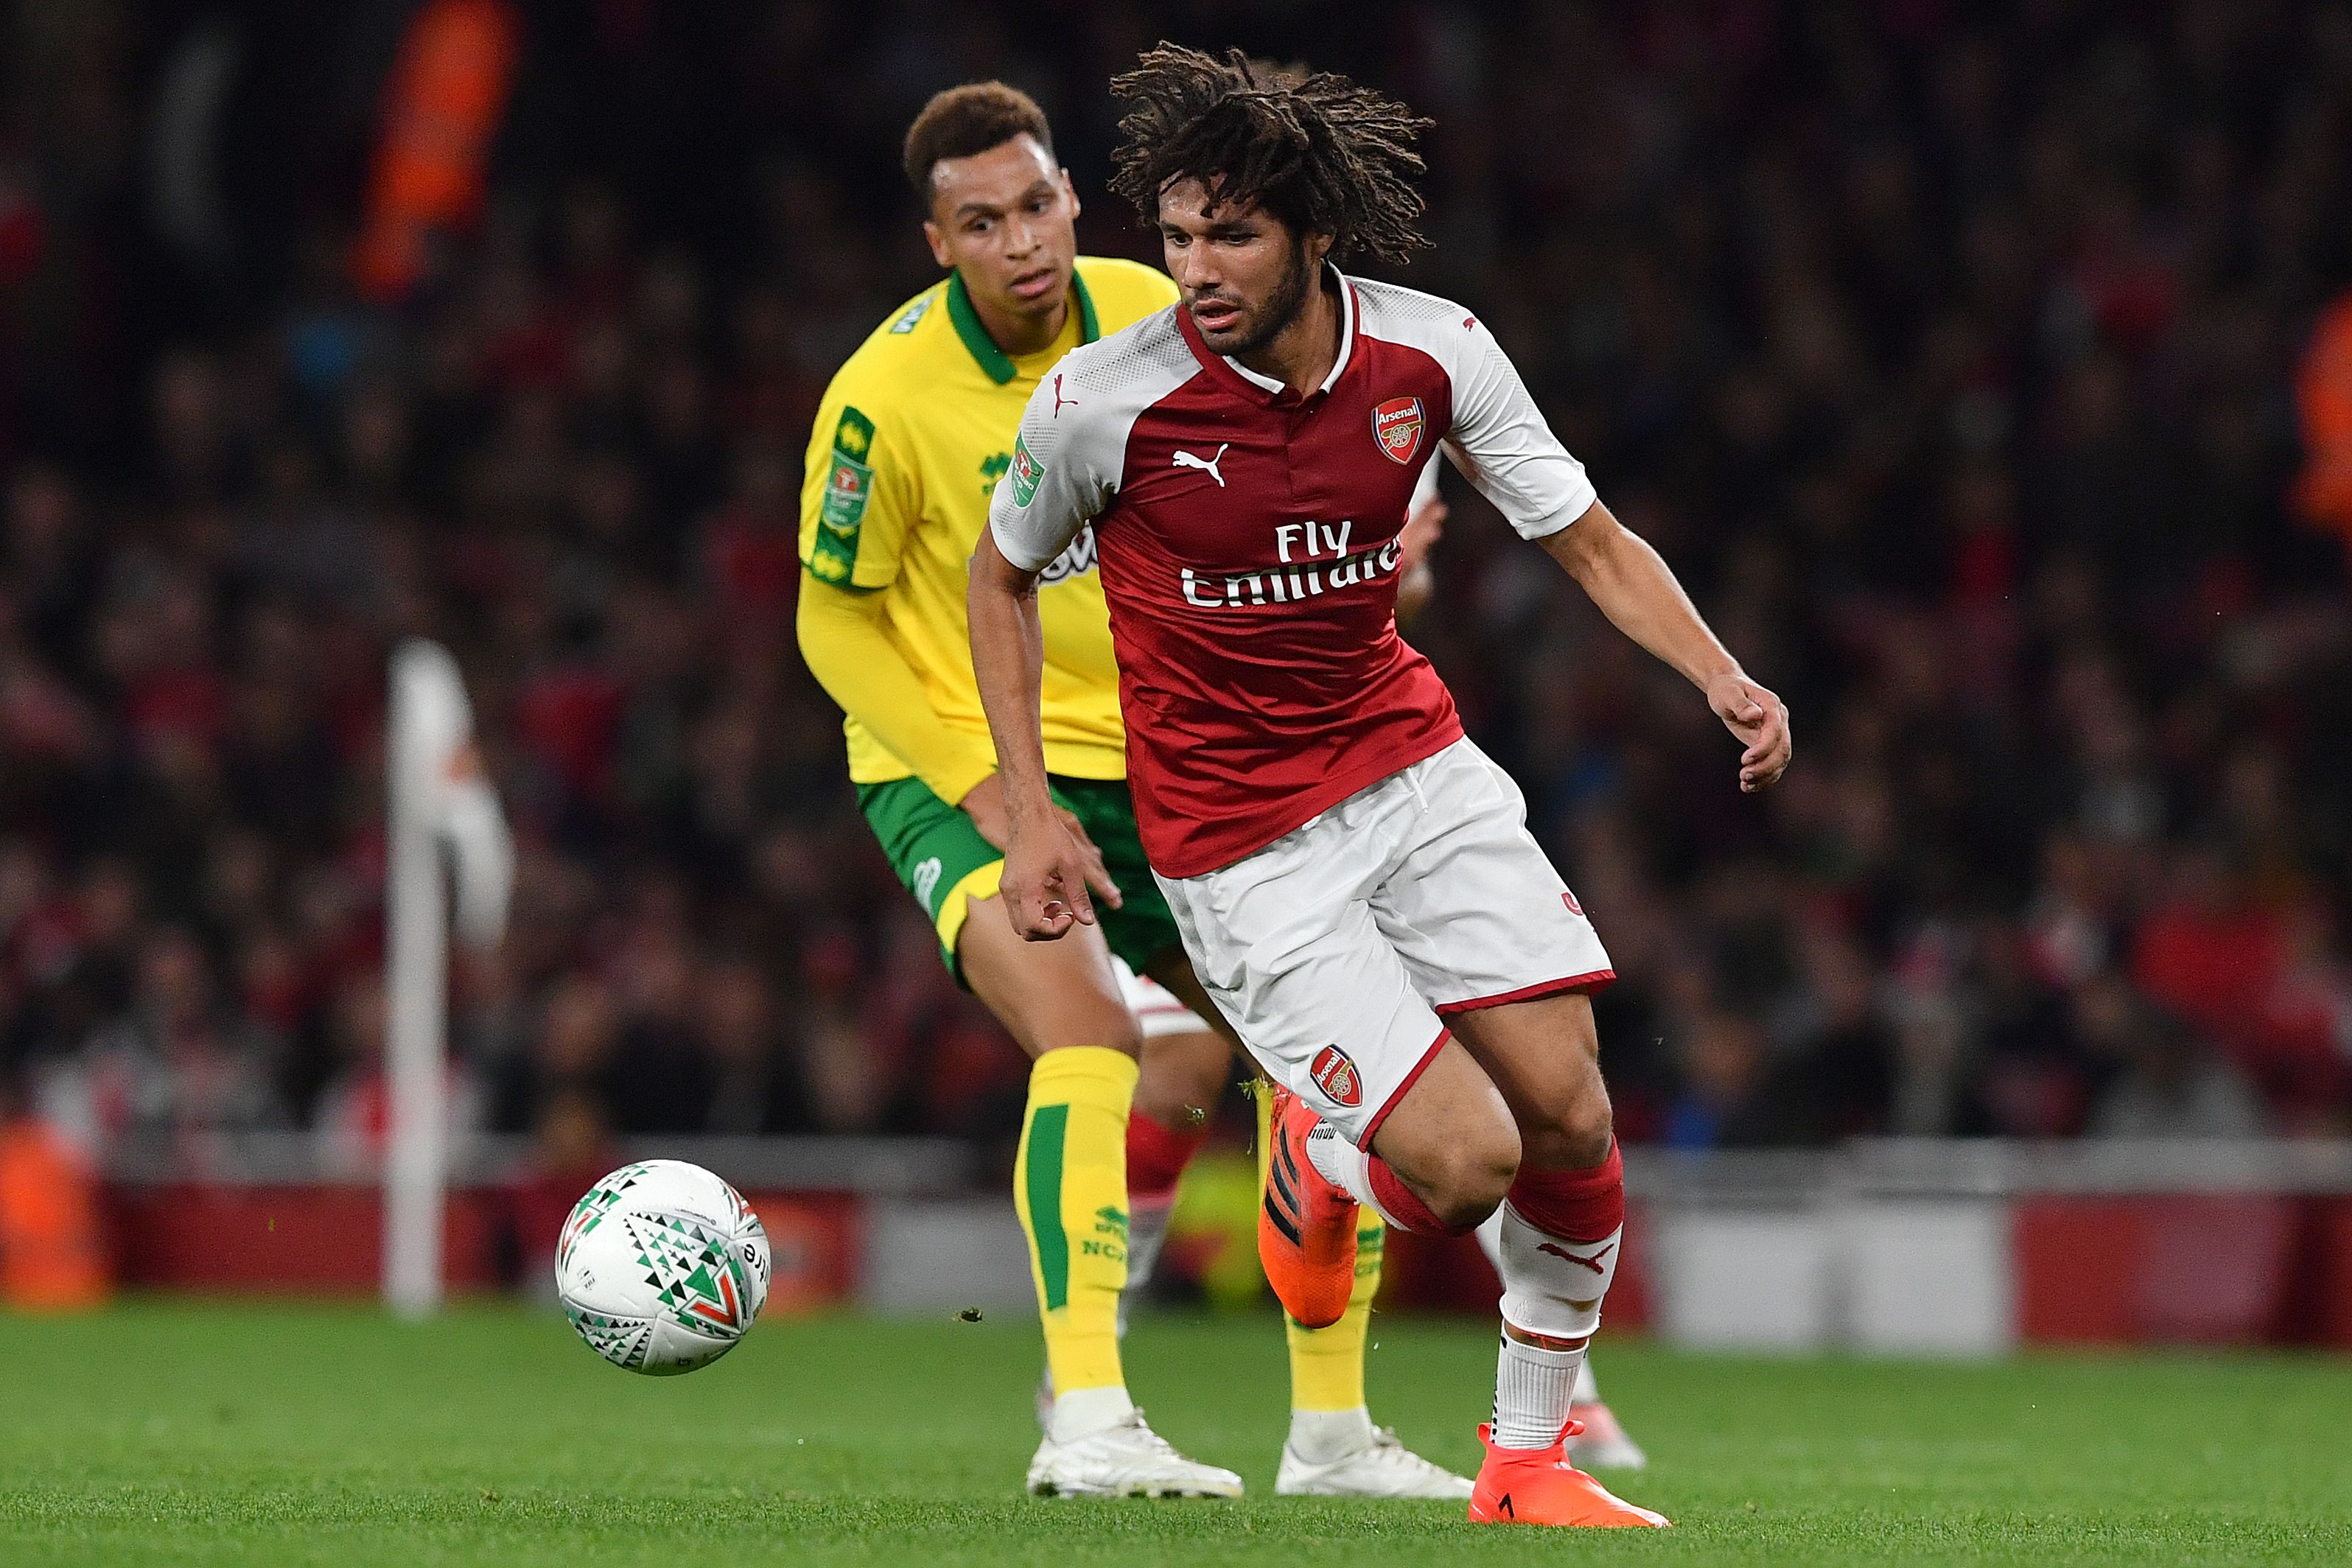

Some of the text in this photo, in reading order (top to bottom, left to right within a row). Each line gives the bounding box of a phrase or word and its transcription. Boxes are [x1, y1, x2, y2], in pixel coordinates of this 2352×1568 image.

[1379, 405, 1417, 424] Arsenal
[1275, 520, 1351, 563] Fly
[1317, 1052, 1341, 1084] Arsenal
